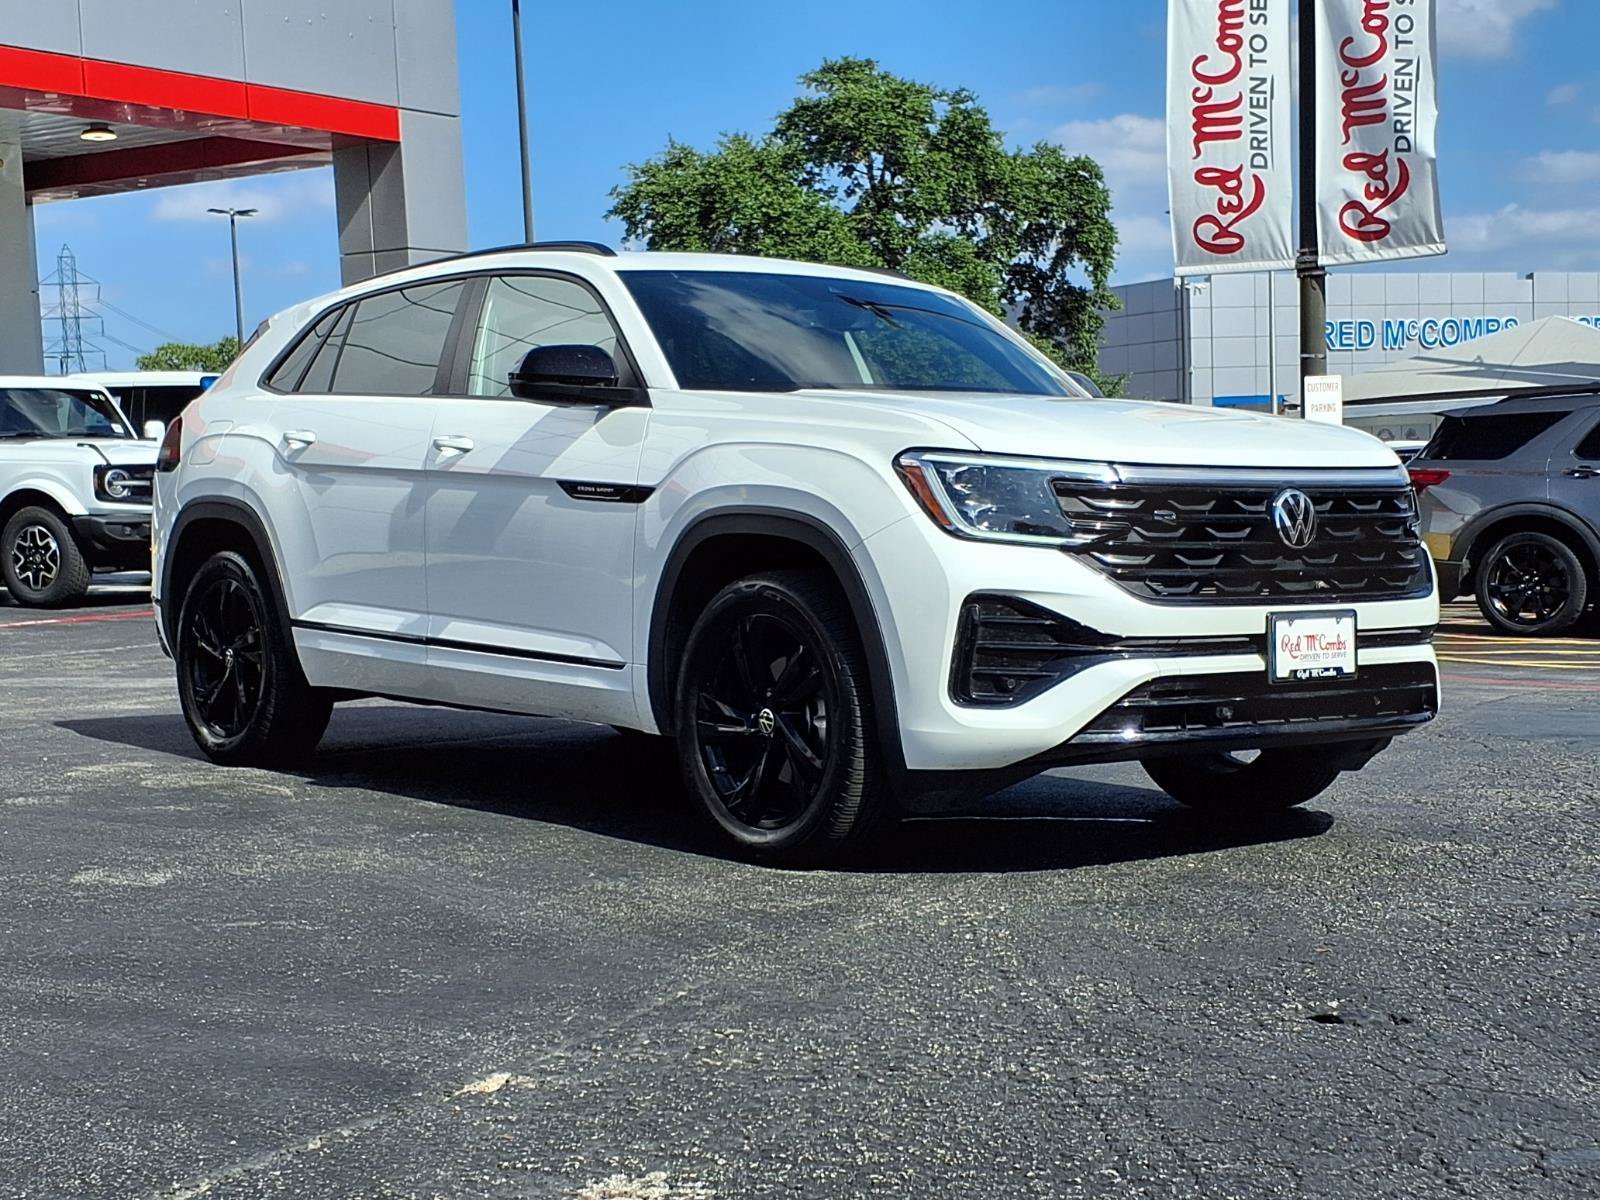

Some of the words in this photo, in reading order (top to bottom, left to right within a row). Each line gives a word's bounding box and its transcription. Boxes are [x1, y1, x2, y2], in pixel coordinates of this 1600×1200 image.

[1394, 14, 1414, 49] TO
[1249, 34, 1267, 68] TO
[1393, 58, 1413, 152] DRIVEN
[1249, 76, 1268, 169] DRIVEN
[1193, 164, 1265, 254] Red
[1339, 147, 1409, 242] Red
[1324, 320, 1376, 349] RED
[1307, 382, 1339, 392] CUSTOMER
[1311, 402, 1336, 414] PARKING
[1281, 634, 1301, 659] Red
[1303, 633, 1347, 651] McCombs
[1297, 669, 1309, 679] Red
